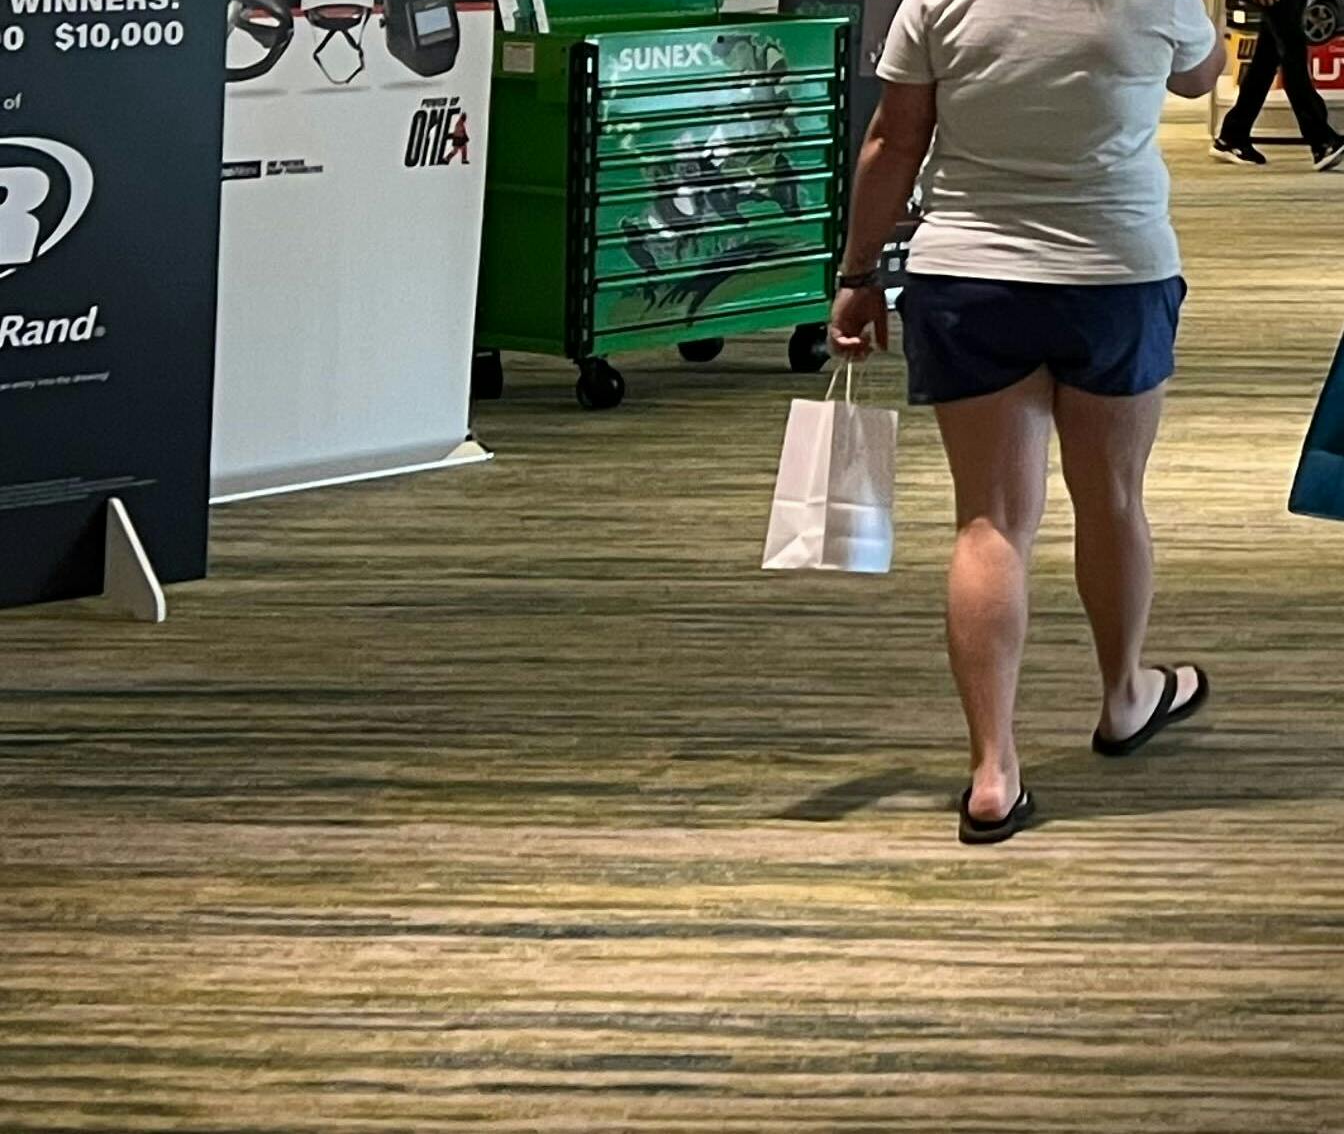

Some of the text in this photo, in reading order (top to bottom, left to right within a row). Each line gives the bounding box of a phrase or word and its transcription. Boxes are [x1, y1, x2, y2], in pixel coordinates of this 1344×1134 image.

[55, 20, 185, 51] $10,000
[618, 42, 702, 72] SUNEX
[3, 92, 22, 110] of
[404, 107, 461, 167] ONE
